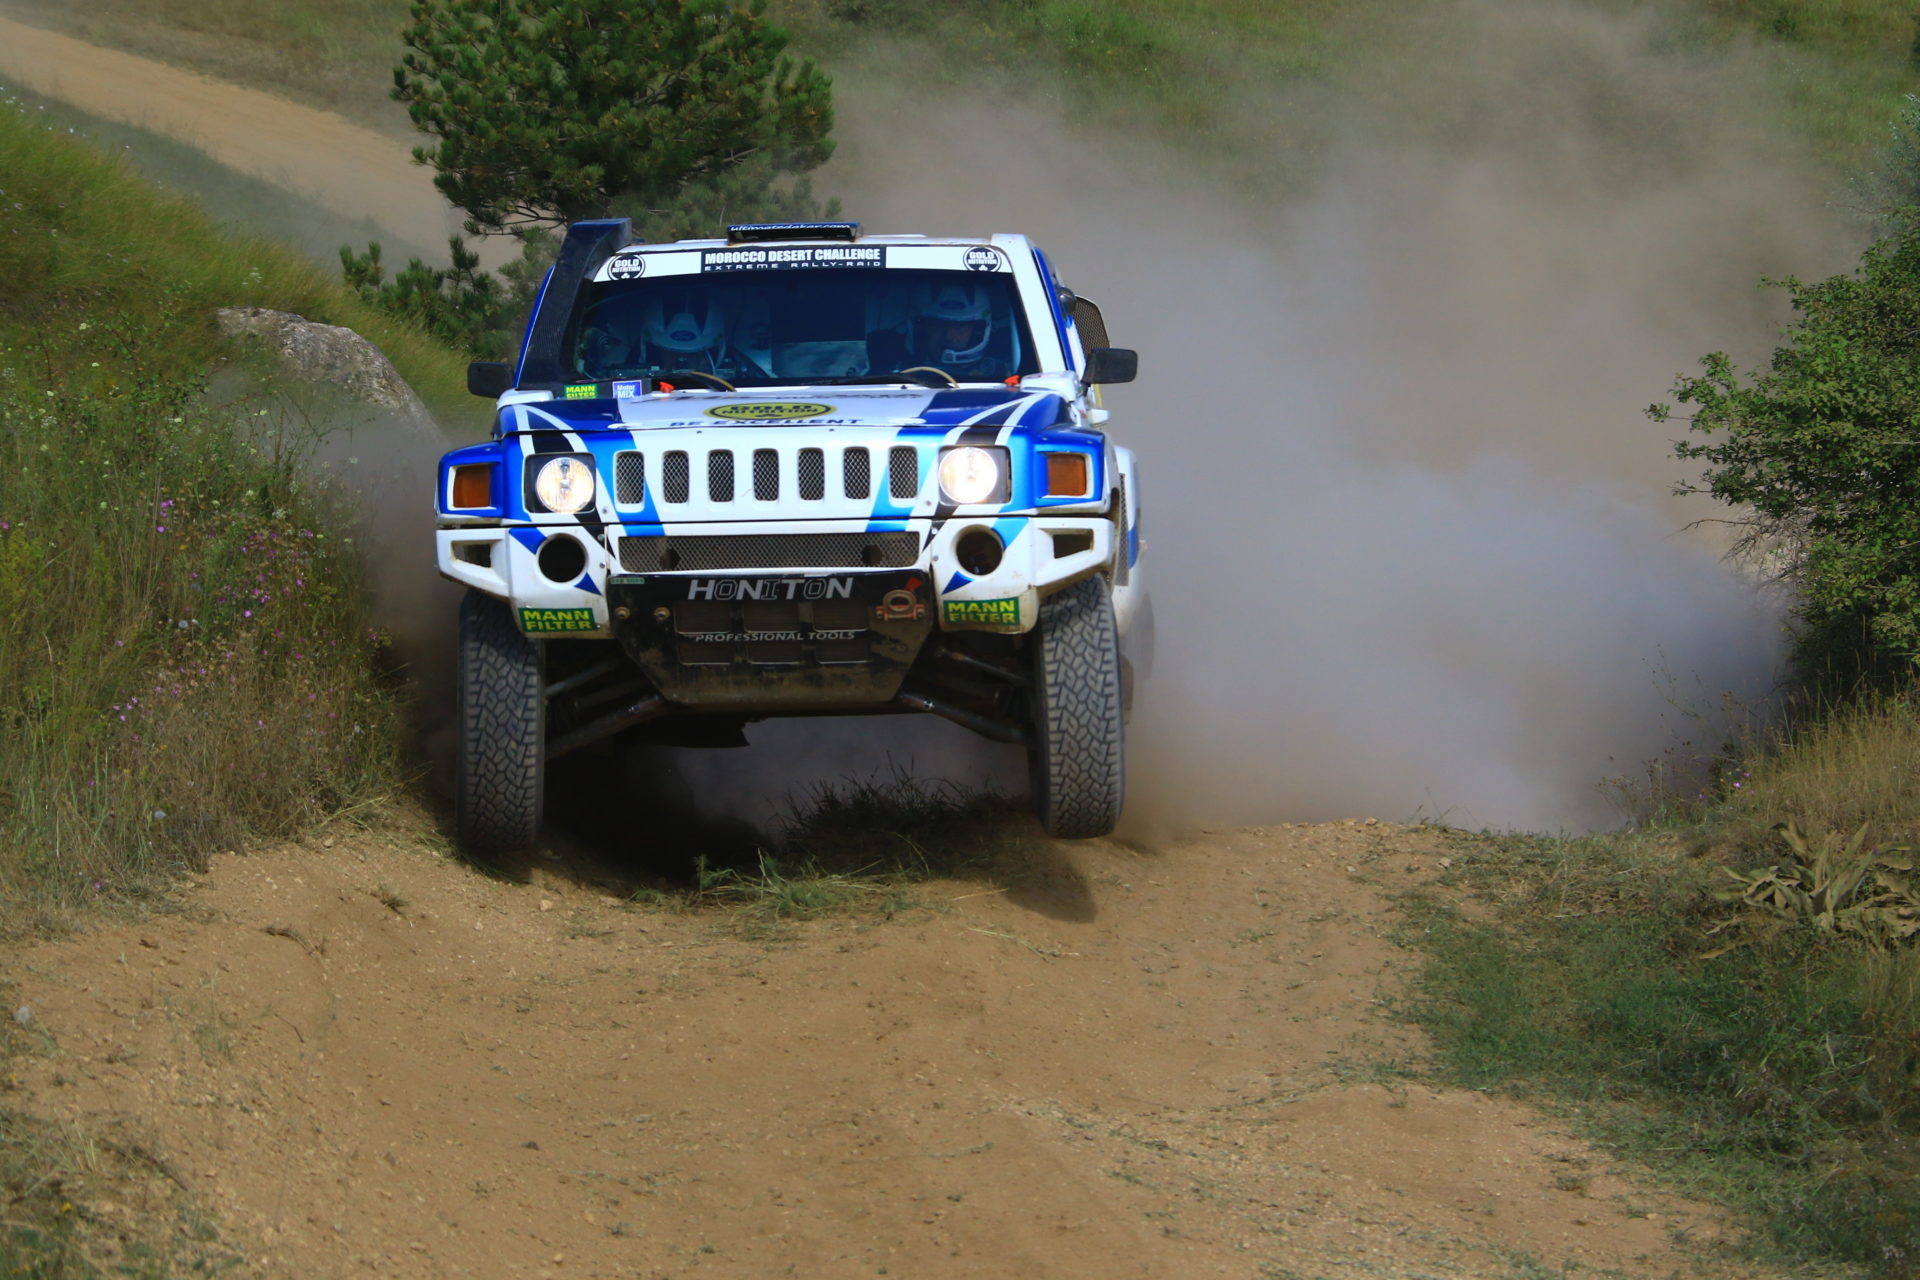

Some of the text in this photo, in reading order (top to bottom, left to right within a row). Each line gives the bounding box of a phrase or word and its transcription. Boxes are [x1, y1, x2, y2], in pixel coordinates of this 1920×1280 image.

[704, 248, 881, 265] MOROCCO DESERT CHALLENGE
[969, 251, 995, 259] GOLD
[614, 258, 639, 268] GOLD
[704, 263, 779, 271] EXTREME
[565, 385, 596, 393] MANN
[687, 577, 854, 600] HONITON
[947, 600, 1015, 612] MANN
[523, 610, 589, 621] MANN
[949, 612, 1016, 624] FILTER
[525, 620, 592, 631] FILTER
[695, 631, 855, 642] PROFESSIONAL TOOLS
